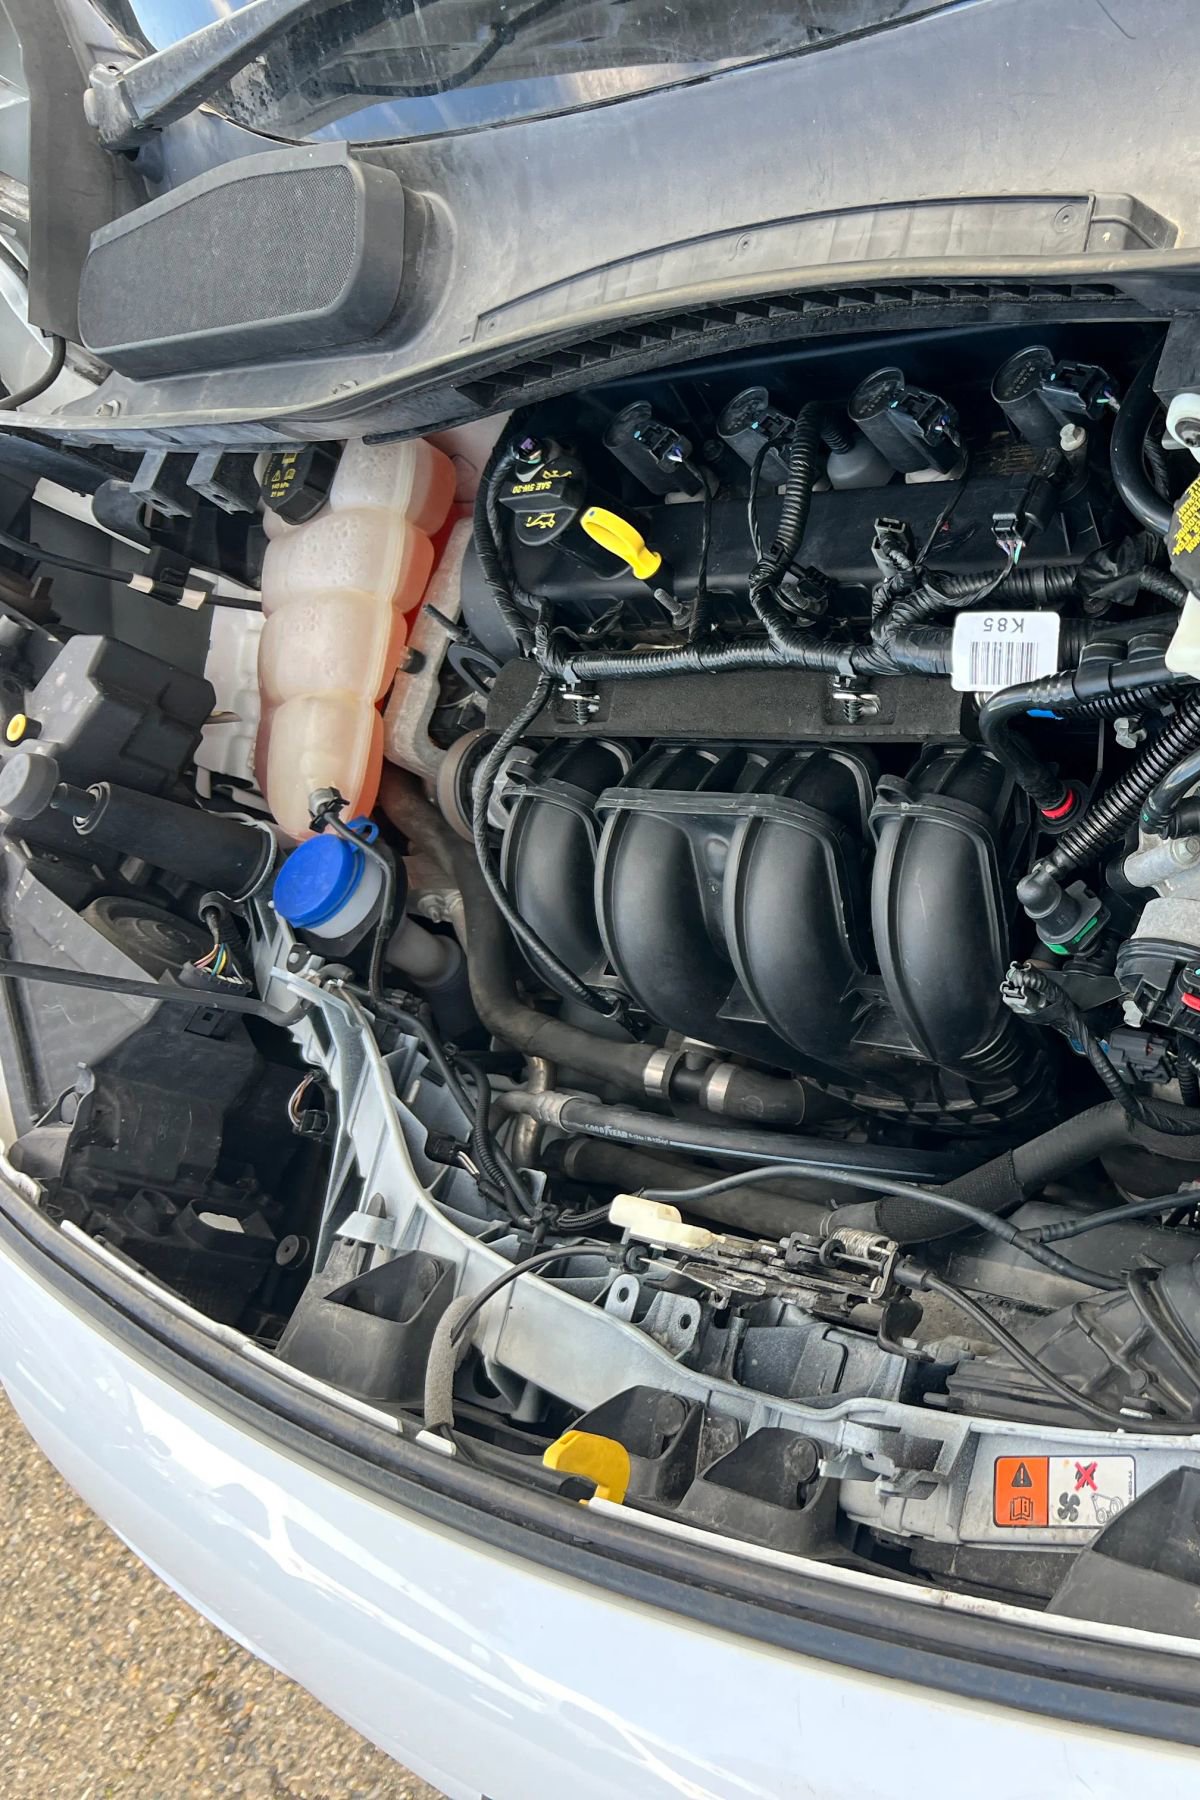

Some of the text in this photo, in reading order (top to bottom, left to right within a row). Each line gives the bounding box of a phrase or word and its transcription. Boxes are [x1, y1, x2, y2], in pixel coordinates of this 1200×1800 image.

[535, 481, 552, 490] SAE
[984, 618, 1024, 632] K85
[585, 1124, 628, 1138] GOODYEAR
